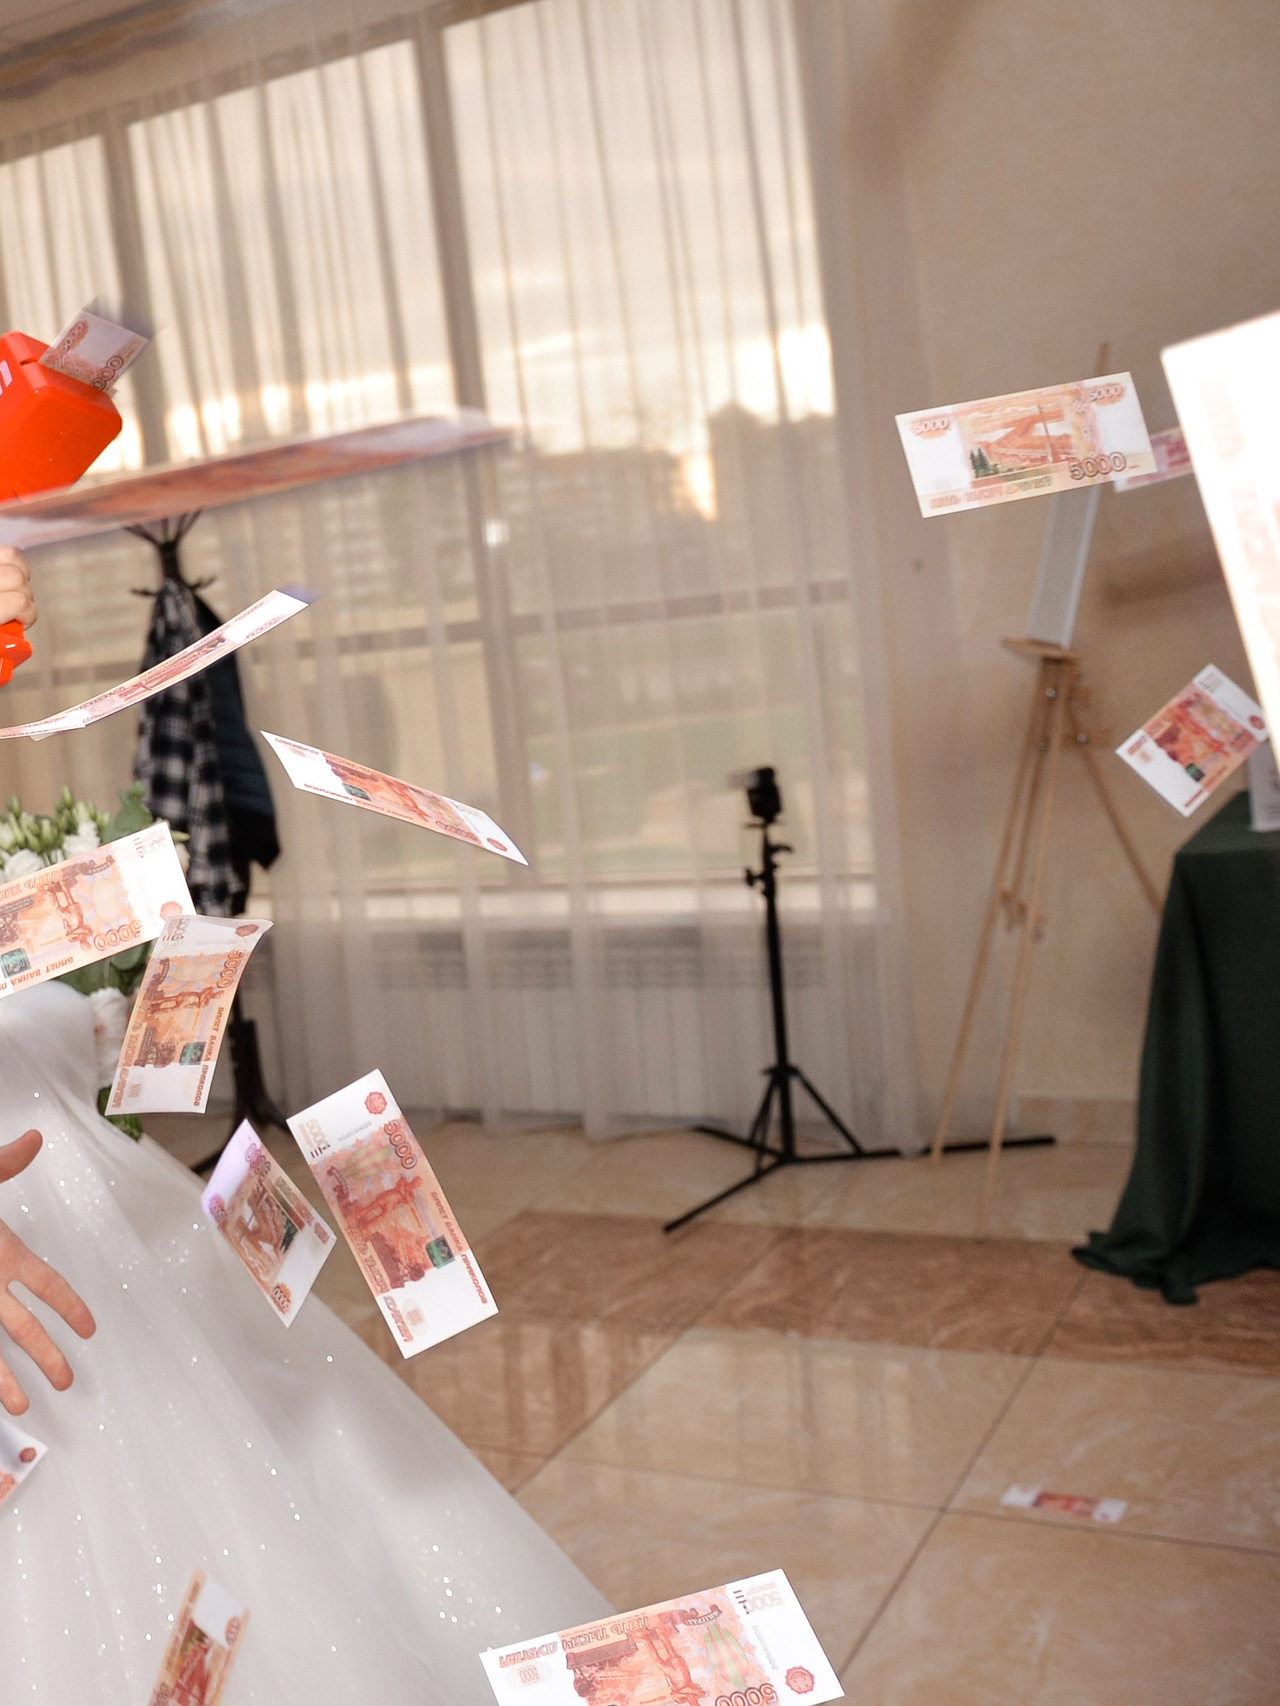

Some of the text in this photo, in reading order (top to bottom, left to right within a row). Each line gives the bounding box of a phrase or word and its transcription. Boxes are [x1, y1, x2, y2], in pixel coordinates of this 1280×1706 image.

[93, 355, 124, 392] 000
[1067, 450, 1128, 481] 5000
[93, 920, 143, 952] 5000
[217, 951, 245, 988] 5000
[382, 1118, 418, 1171] 5000
